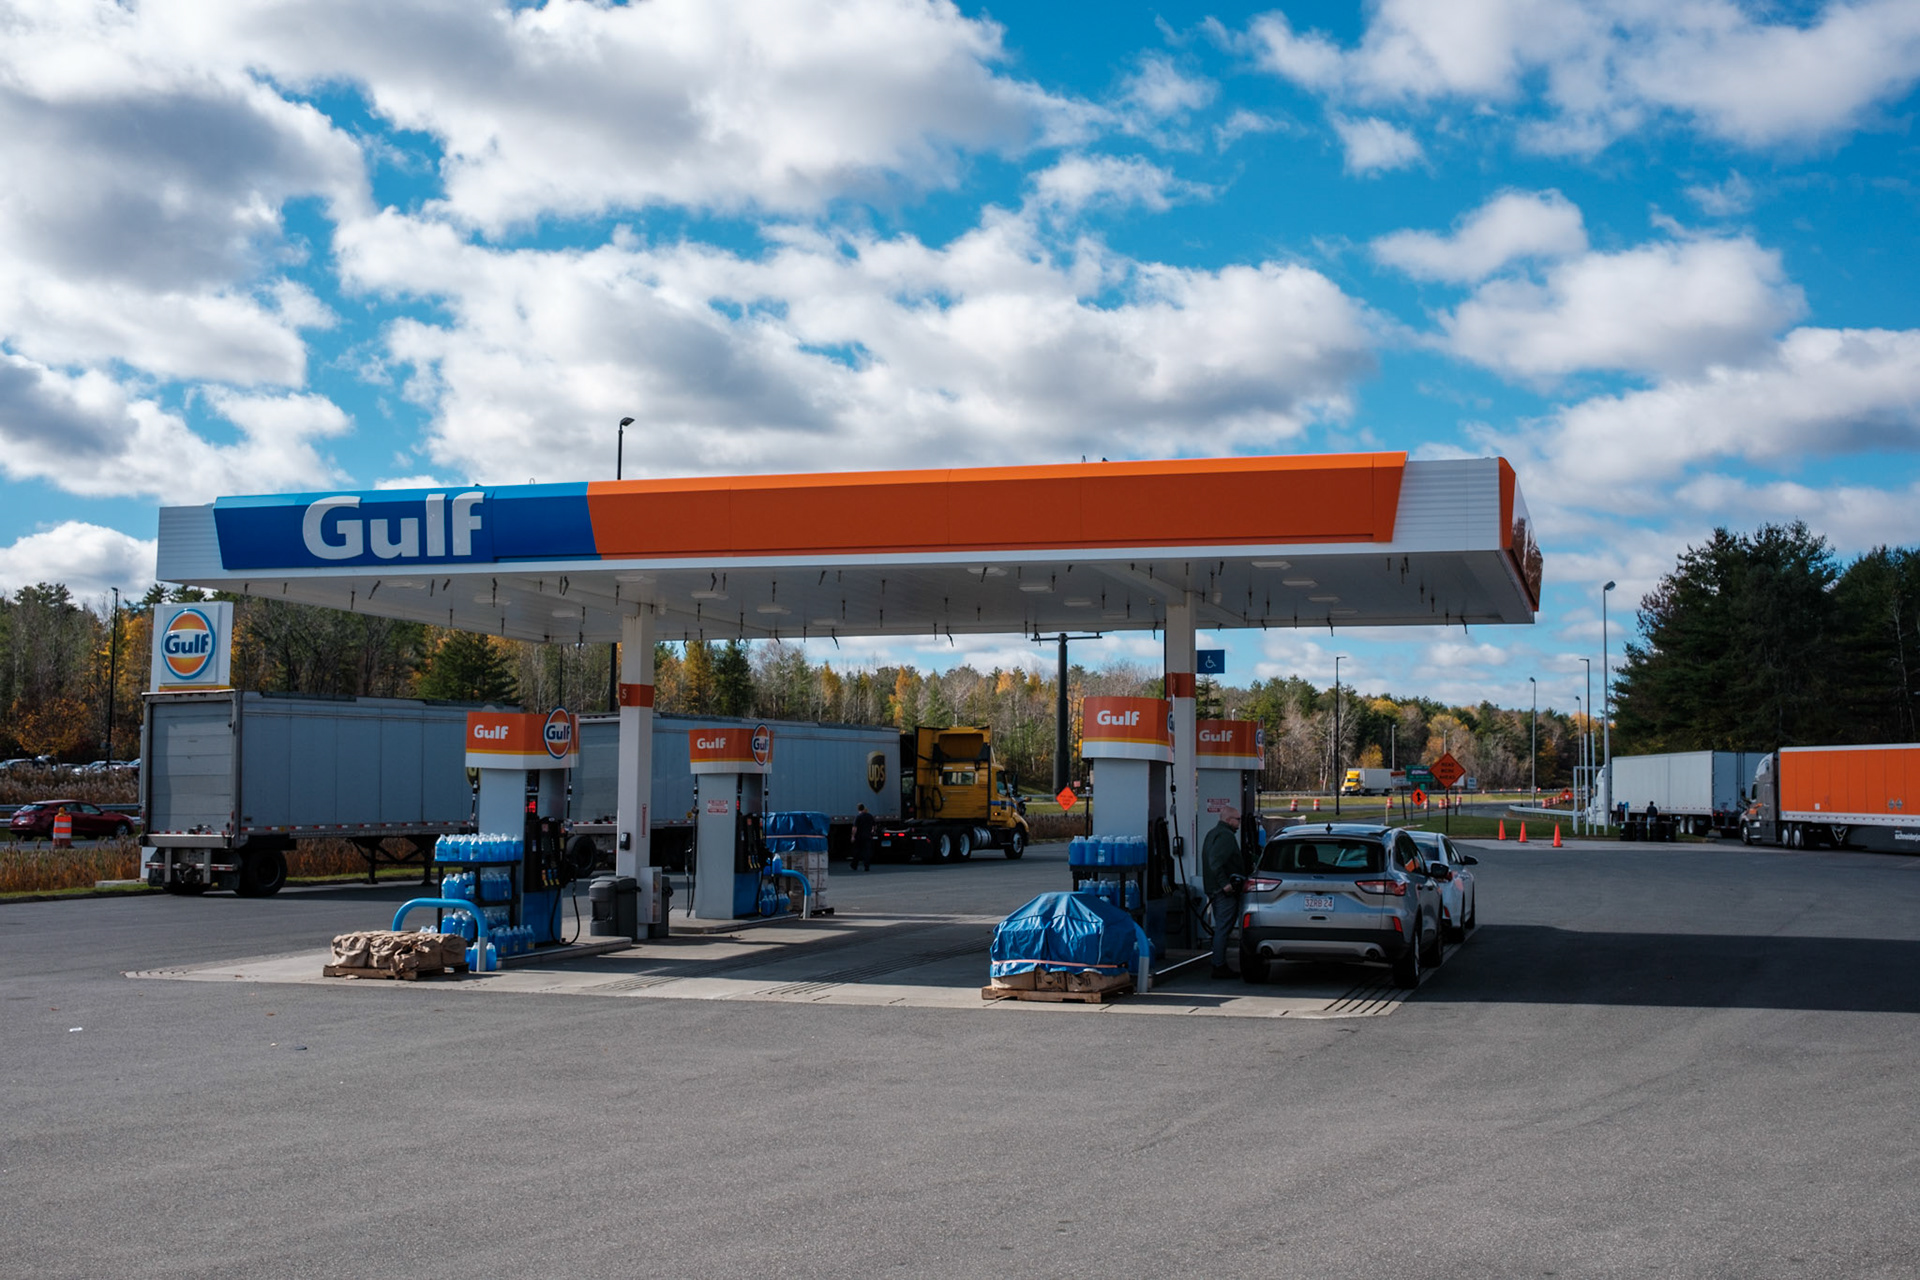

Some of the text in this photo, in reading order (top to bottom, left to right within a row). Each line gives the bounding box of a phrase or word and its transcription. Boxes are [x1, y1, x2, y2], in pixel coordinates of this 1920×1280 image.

[302, 491, 485, 560] Gulf
[164, 633, 210, 654] Gulf
[1097, 710, 1140, 726] Gulf
[473, 724, 509, 740] Gulf
[546, 724, 571, 740] Gulf
[1199, 729, 1233, 742] Gulf
[696, 737, 727, 749] Gulf
[868, 764, 886, 788] ups
